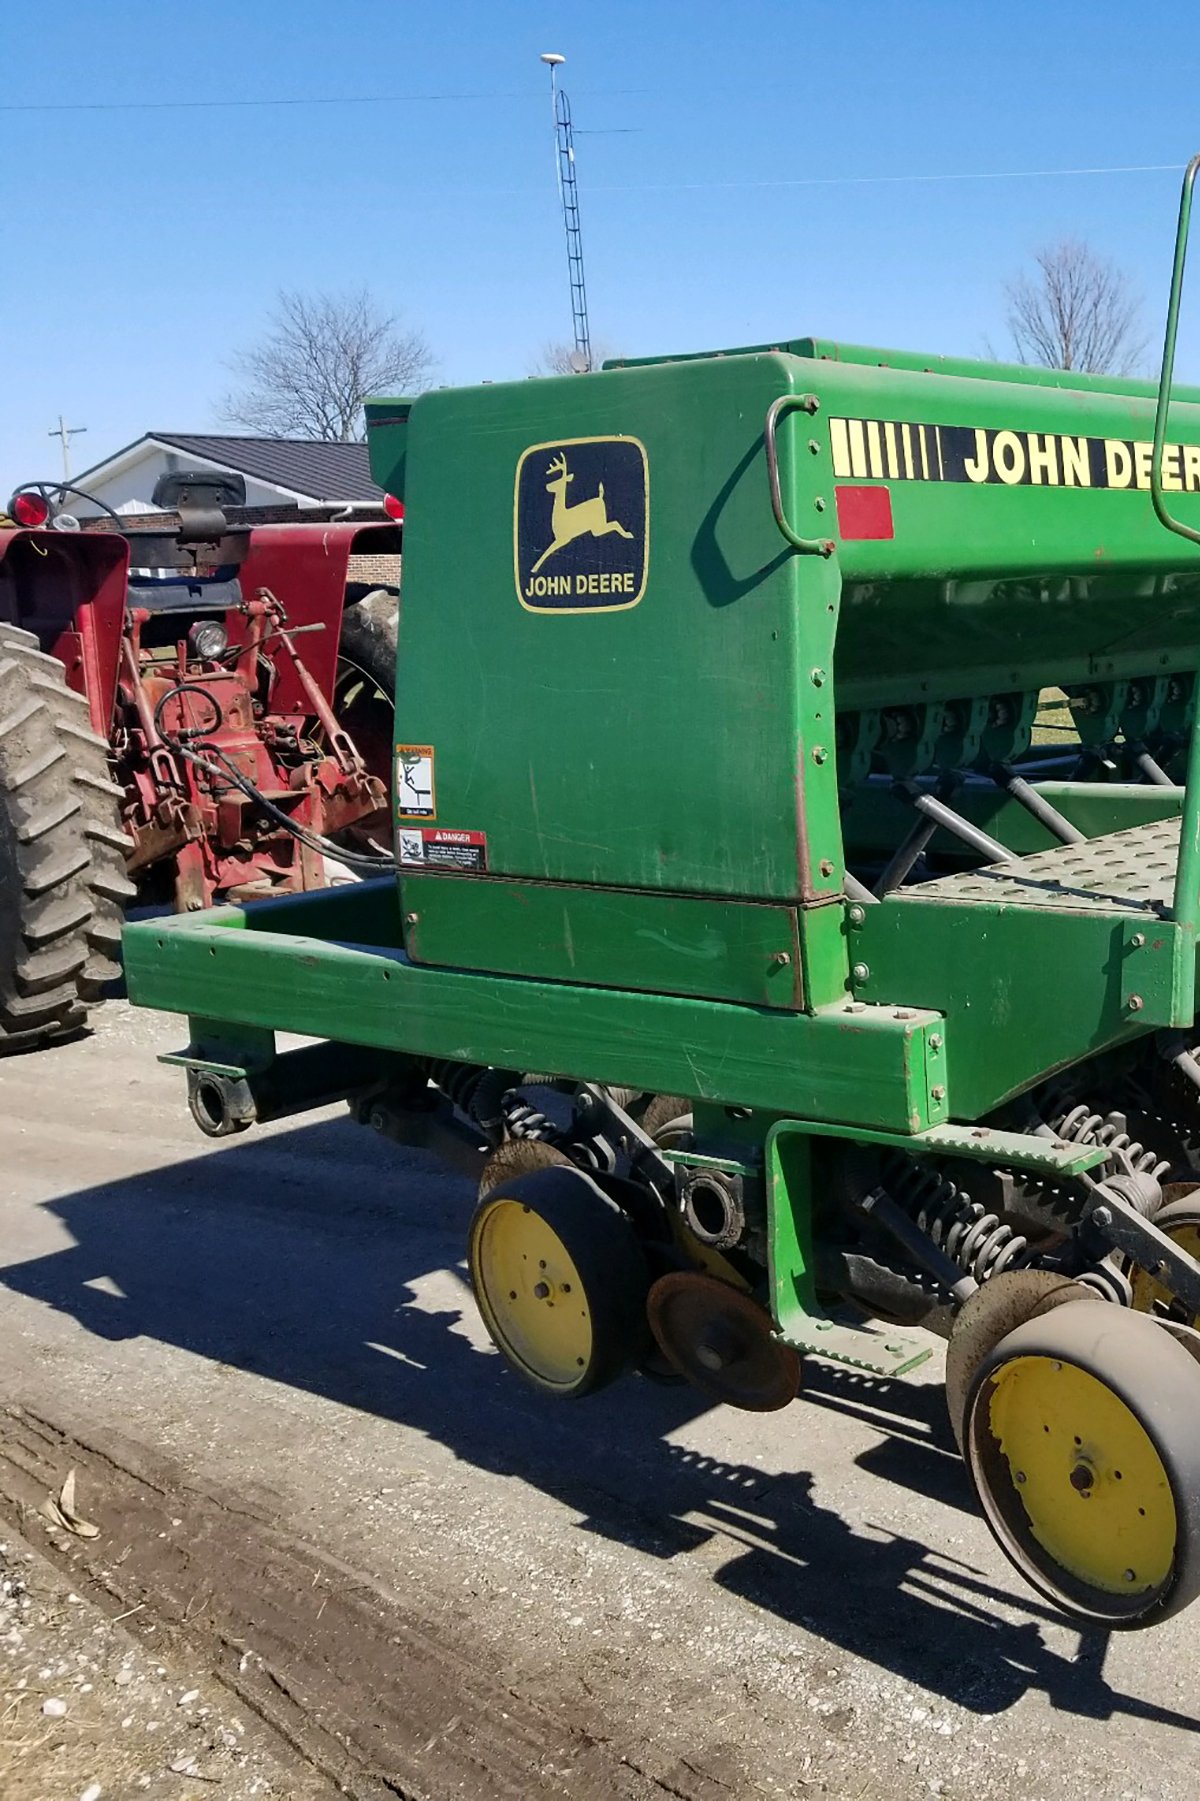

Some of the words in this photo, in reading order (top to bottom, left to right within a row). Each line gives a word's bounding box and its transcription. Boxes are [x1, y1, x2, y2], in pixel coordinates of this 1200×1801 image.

[964, 428, 1091, 485] JOHN
[525, 575, 571, 597] JOHN
[576, 572, 635, 595] DEERE
[442, 832, 470, 843] DANGER
